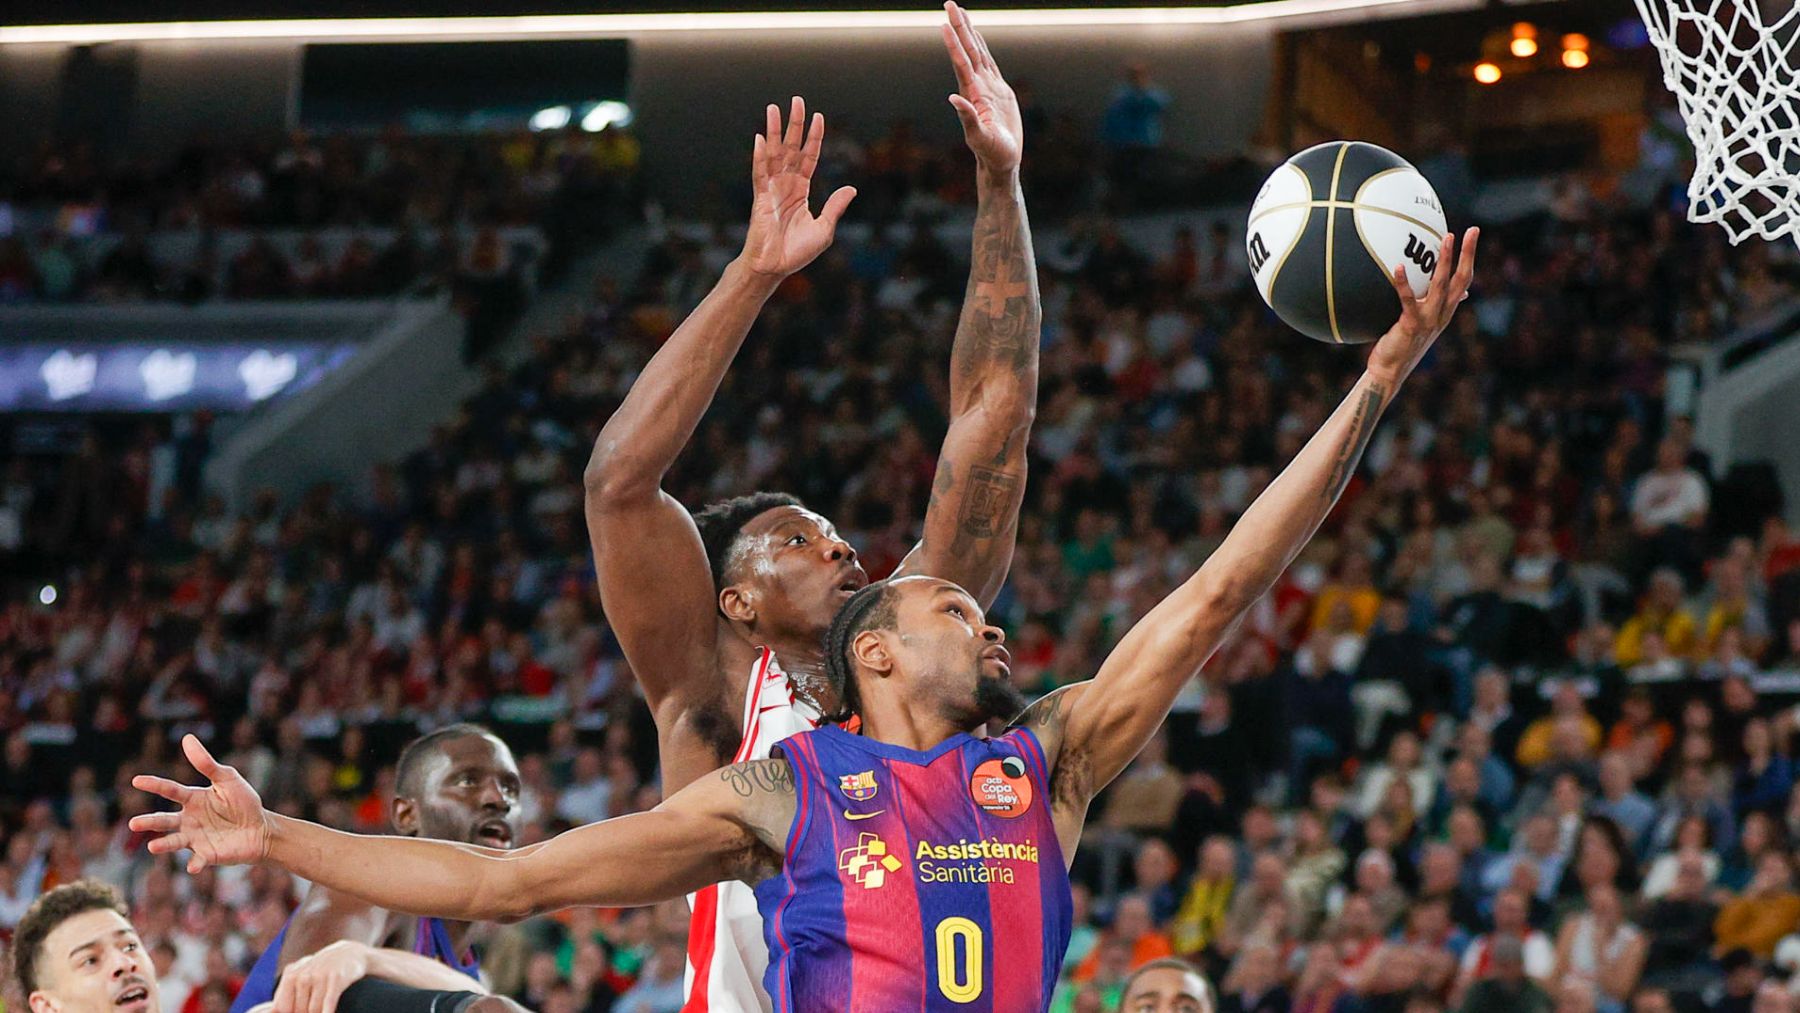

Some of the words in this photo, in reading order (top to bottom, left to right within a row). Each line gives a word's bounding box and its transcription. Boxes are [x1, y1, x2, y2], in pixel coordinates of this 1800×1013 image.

[981, 783, 1012, 794] Copa
[997, 794, 1018, 805] Rey
[916, 837, 1039, 863] Assistència
[919, 861, 1015, 884] Sanitària
[935, 916, 983, 1003] 0
